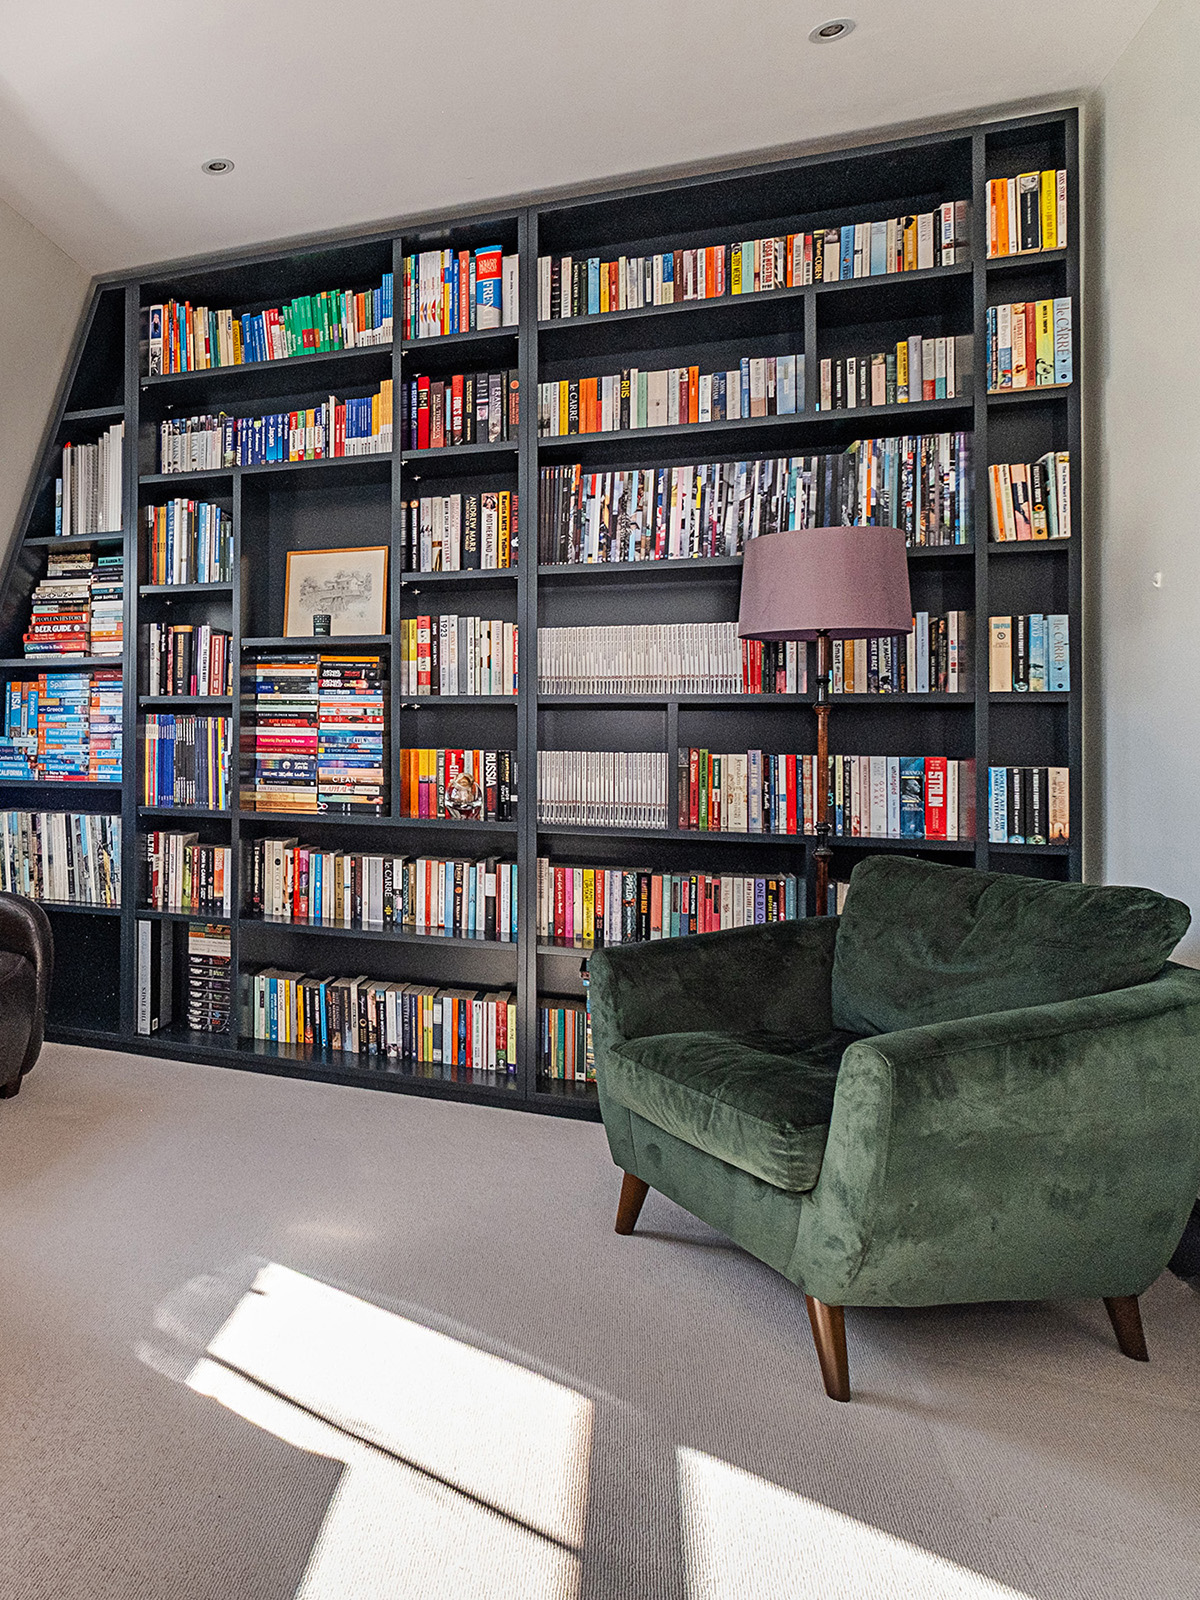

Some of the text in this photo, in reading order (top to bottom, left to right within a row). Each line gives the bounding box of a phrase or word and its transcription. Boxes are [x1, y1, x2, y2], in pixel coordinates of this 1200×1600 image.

[765, 240, 773, 283] COSA NOSTRA
[814, 255, 823, 280] COBEN
[569, 383, 579, 421] le CARRÉ
[267, 426, 276, 448] Japan
[469, 497, 477, 529] ANDREW
[485, 513, 493, 553] MOTHERLAND
[34, 625, 52, 633] BEER
[11, 692, 21, 710] USA
[29, 693, 37, 716] France
[485, 752, 497, 787] RUSSIA
[890, 764, 898, 794] untangled
[928, 770, 944, 807] STALIN
[385, 861, 393, 898] le CARRÉ
[756, 882, 765, 911] ONE BY
